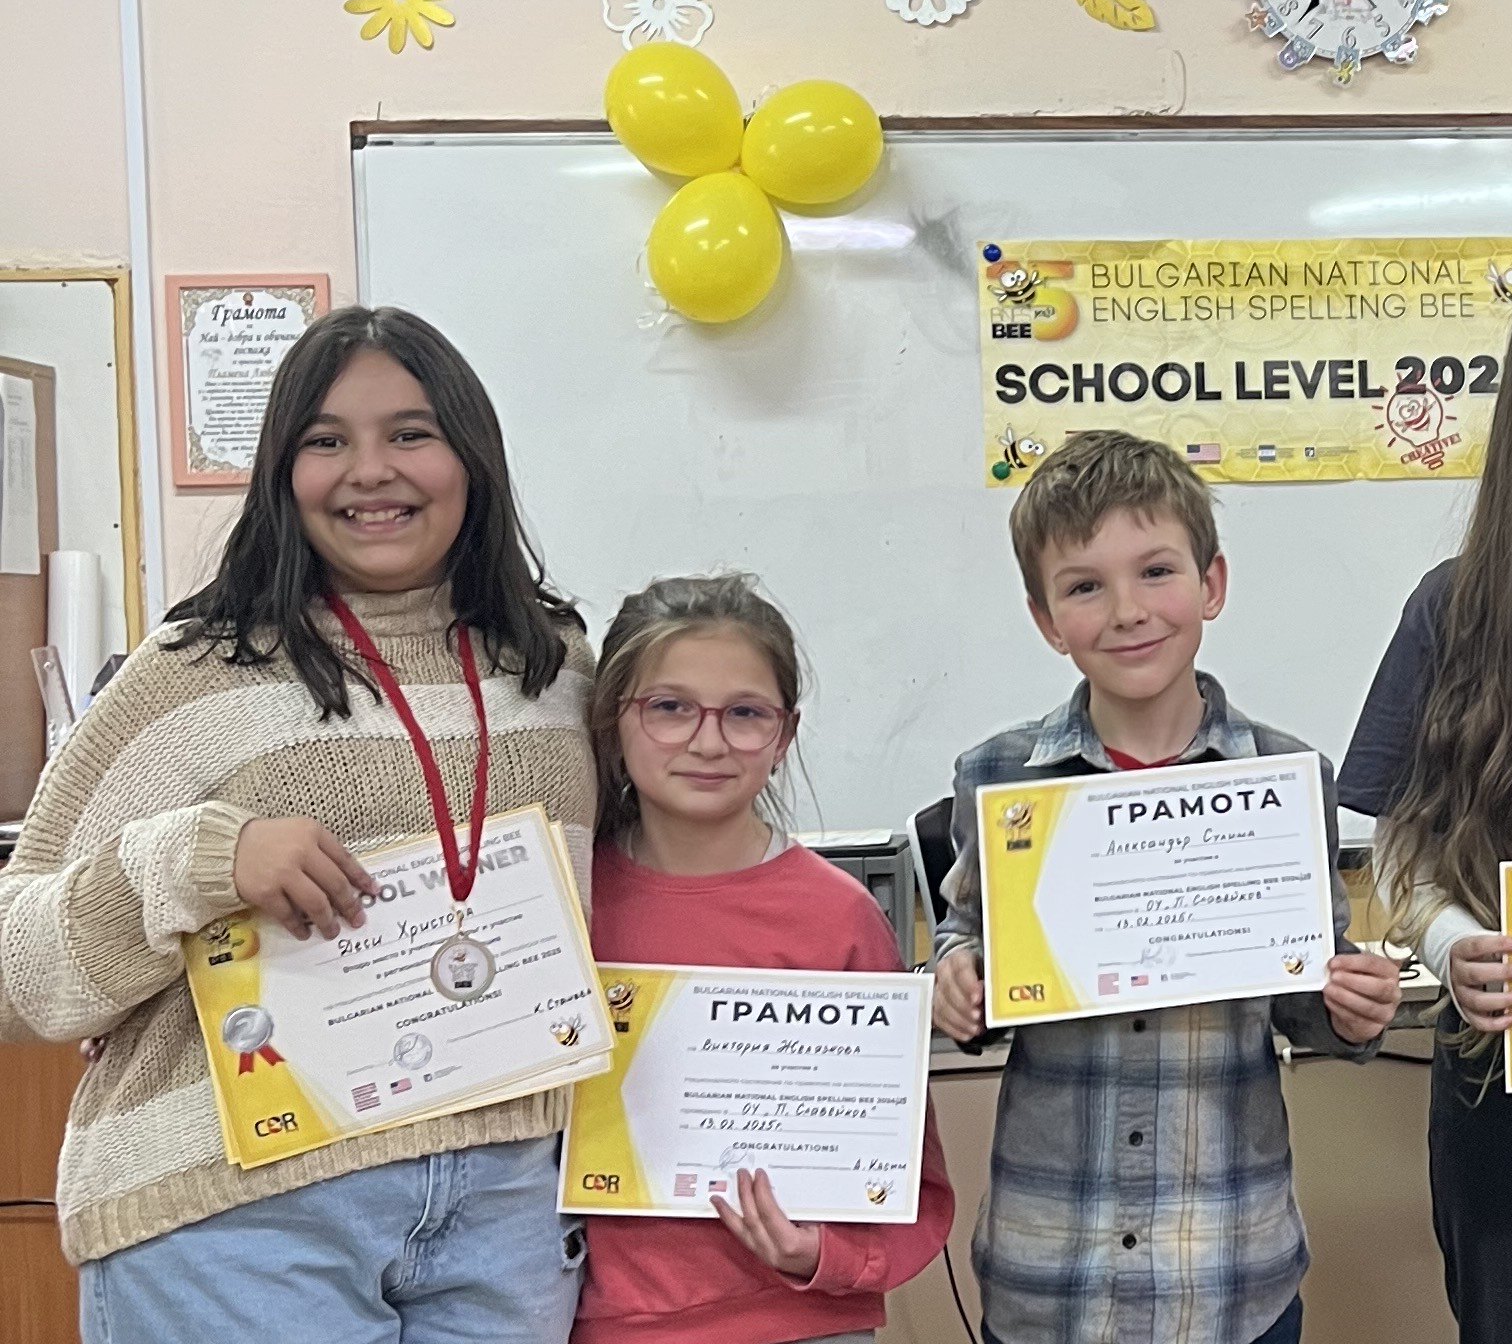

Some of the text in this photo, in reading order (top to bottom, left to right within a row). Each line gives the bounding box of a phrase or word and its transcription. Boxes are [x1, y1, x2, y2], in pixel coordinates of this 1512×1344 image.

[1307, 17, 1324, 39] 7
[1374, 14, 1390, 37] 5
[1342, 26, 1356, 49] 6
[1092, 261, 1472, 288] BULGARIAN NATIONAL
[211, 305, 287, 326] Грамота
[1093, 293, 1475, 322] ENGLISH SPELLING BEE
[992, 324, 1032, 339] BEE
[996, 362, 1222, 404] SCHOOL
[1236, 360, 1384, 400] LEVEL
[1108, 788, 1282, 825] ГРАМОТА
[371, 829, 522, 879] TIONAL BEE
[1106, 835, 1191, 856] Александър
[360, 844, 530, 909] OOL WNER
[338, 936, 382, 957] Деси
[1149, 927, 1251, 944] CONGRATULATIONS!
[328, 1002, 384, 1027] BULGARIAN
[387, 987, 434, 1010] NATIONAL
[522, 954, 539, 967] BEE
[693, 986, 909, 1000] BULGARIAN NATIONAL ENGLISH SPELLING BEE
[396, 989, 502, 1029] CONGRATULATIONS!
[710, 1000, 890, 1026] ГРАМОТА
[732, 1142, 839, 1152] CONGRATULATIONS!
